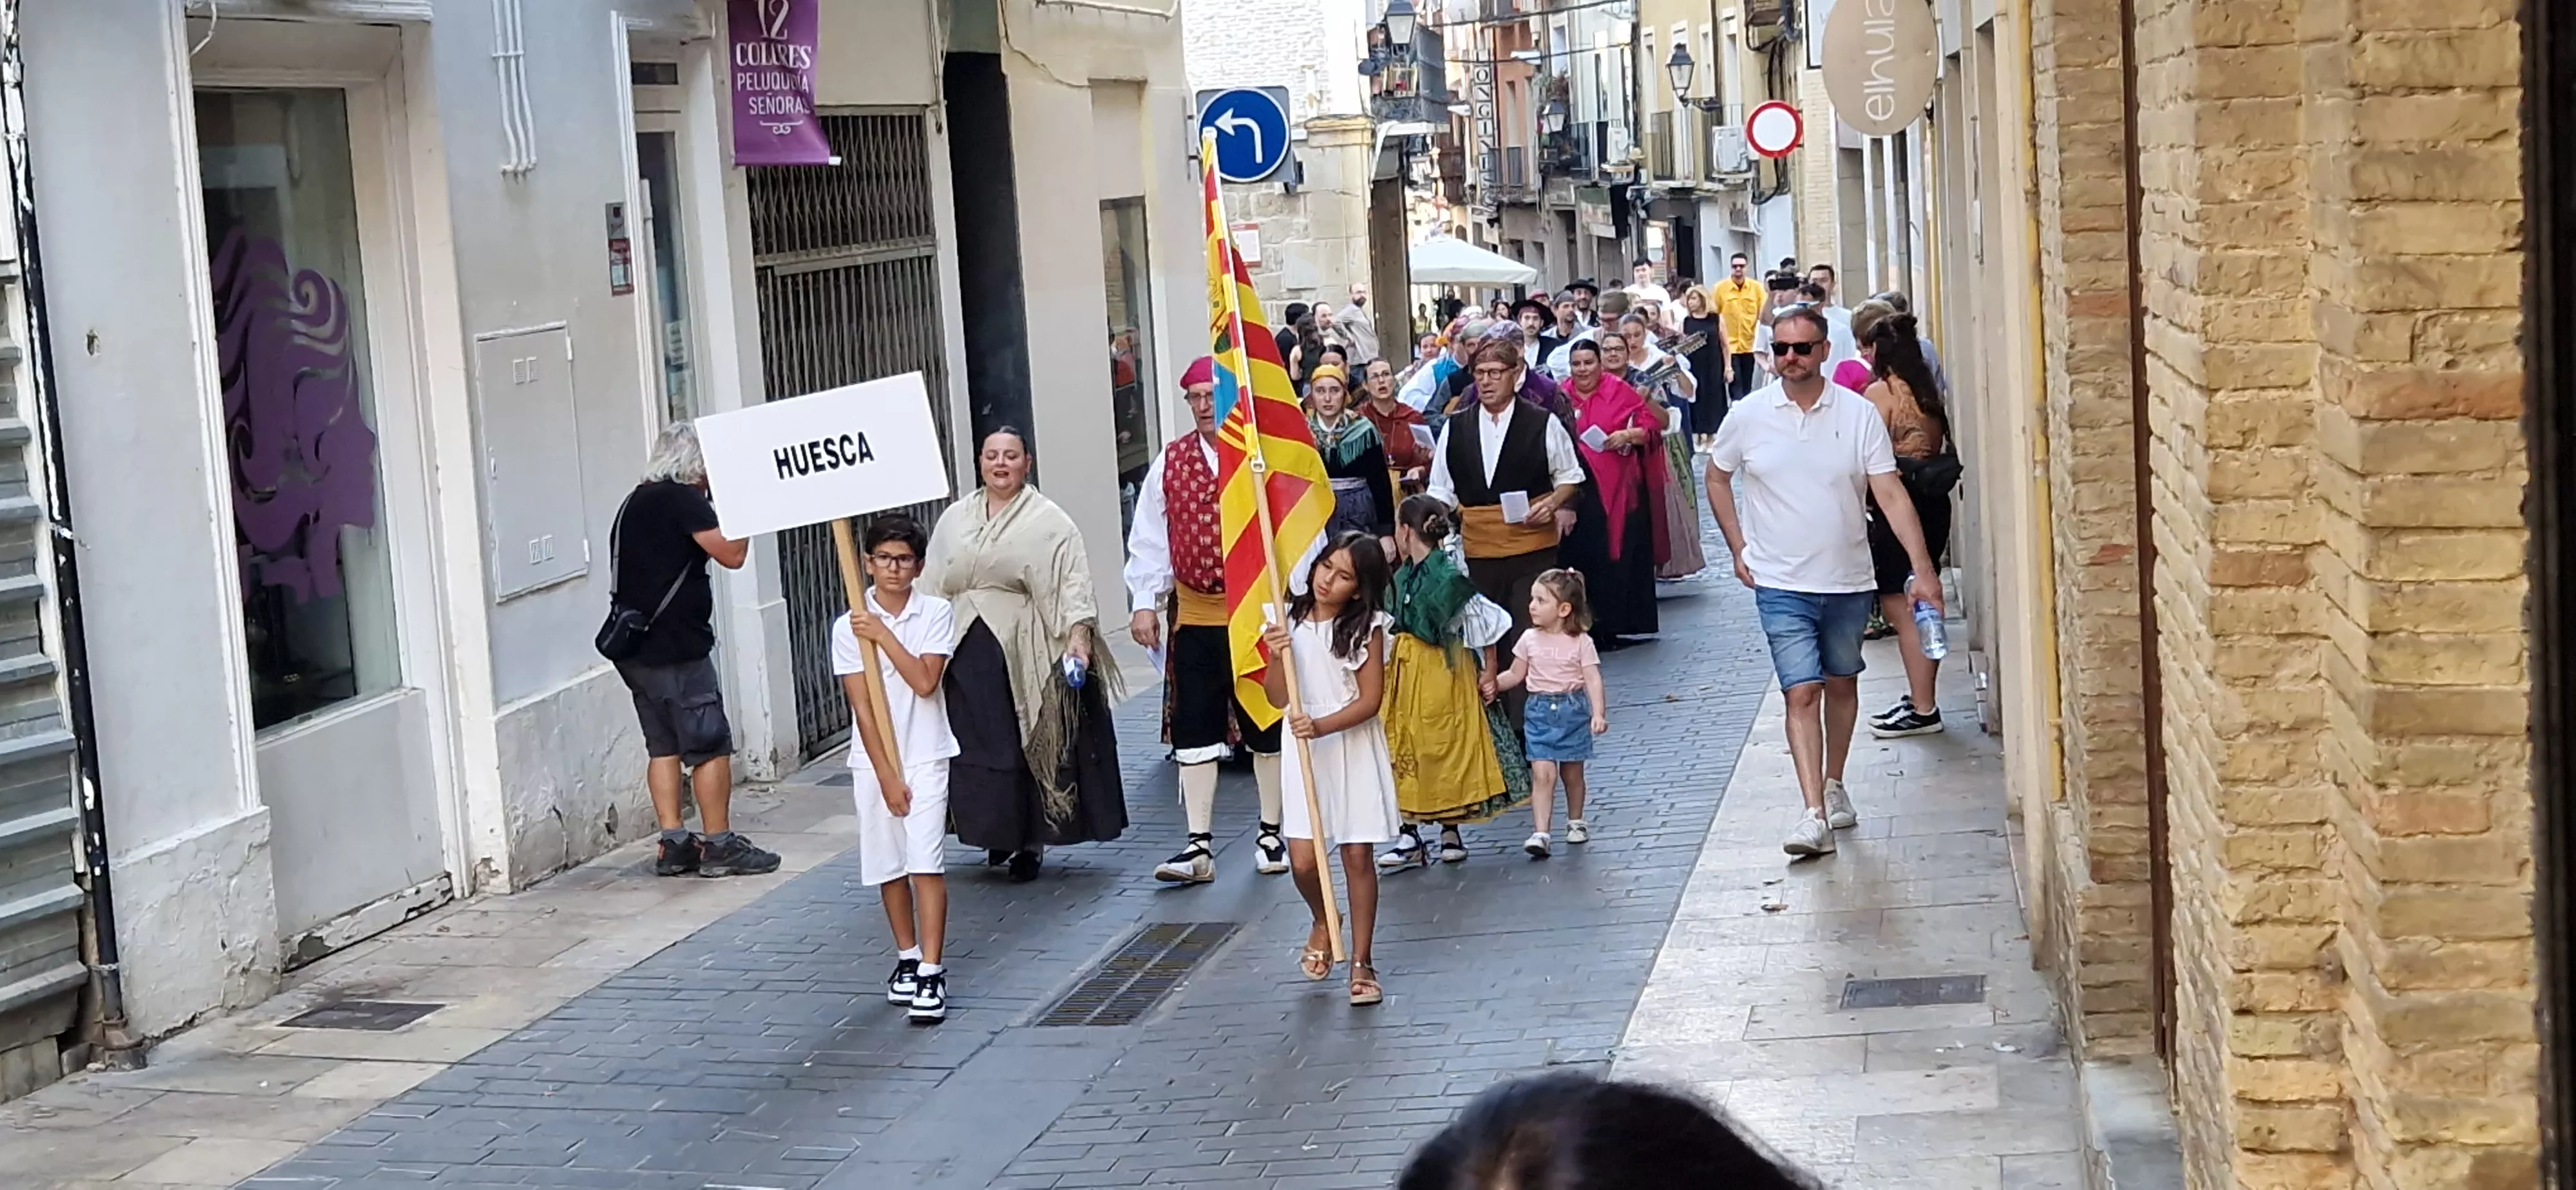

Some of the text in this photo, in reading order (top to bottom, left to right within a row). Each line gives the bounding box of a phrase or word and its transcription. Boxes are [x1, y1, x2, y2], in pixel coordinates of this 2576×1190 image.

[758, 0, 789, 40] 12
[737, 70, 809, 93] PELUQUÍA
[773, 431, 874, 480] HUESCA
